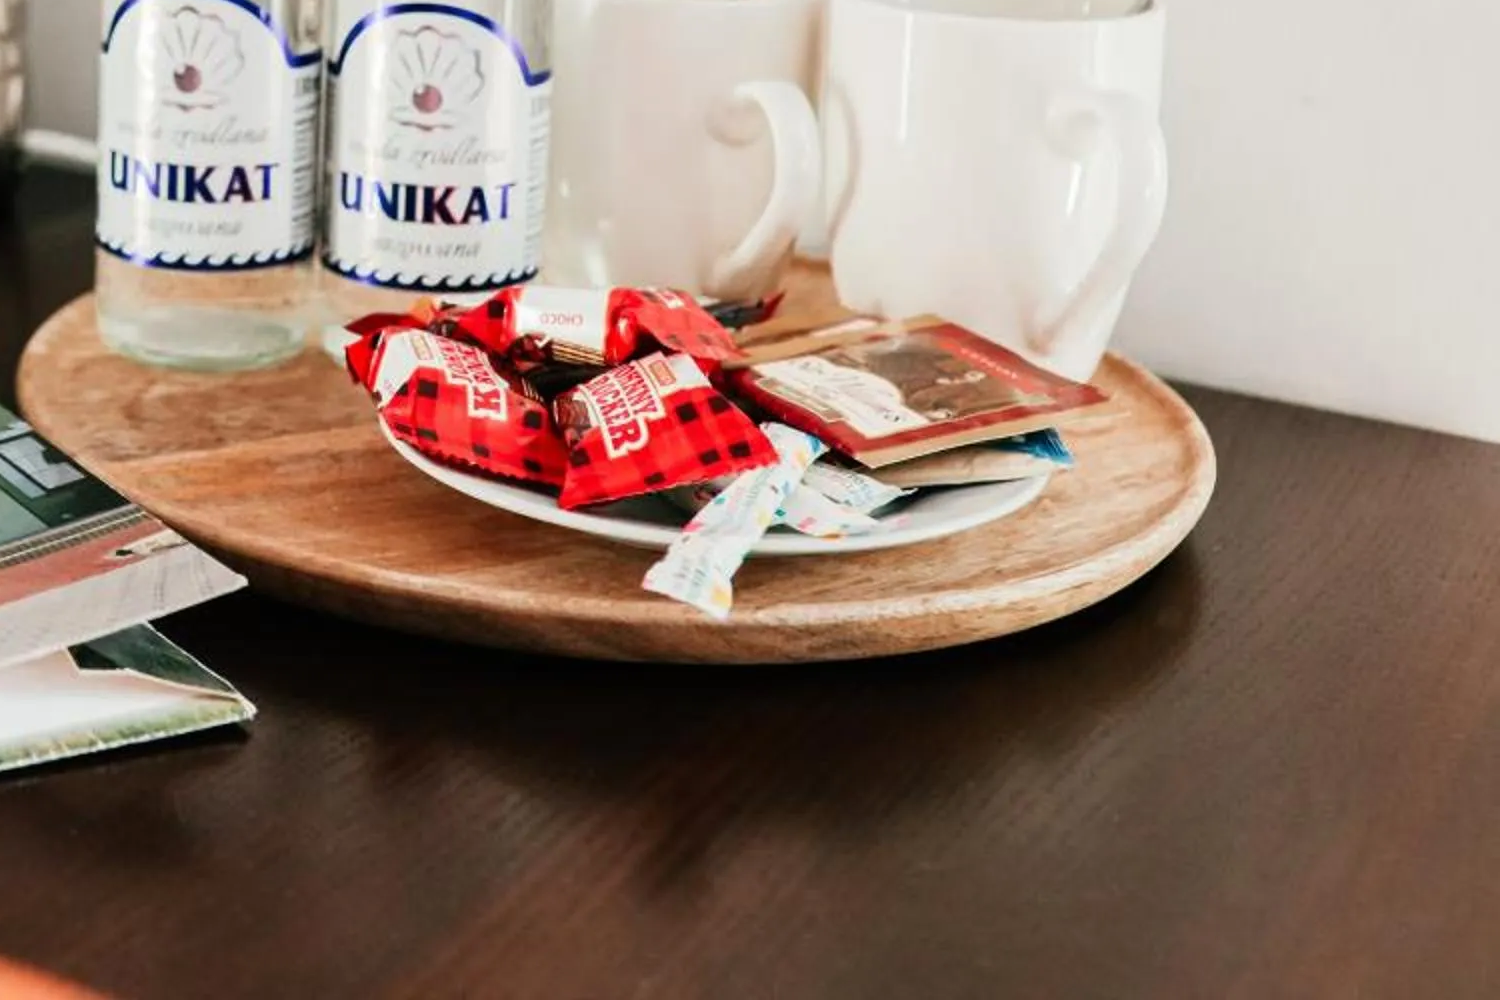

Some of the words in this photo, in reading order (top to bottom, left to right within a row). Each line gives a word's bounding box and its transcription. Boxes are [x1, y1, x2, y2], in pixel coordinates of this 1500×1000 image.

[109, 149, 280, 204] UNIKAT
[341, 171, 518, 225] UNIKAT
[539, 312, 584, 327] CHOCO
